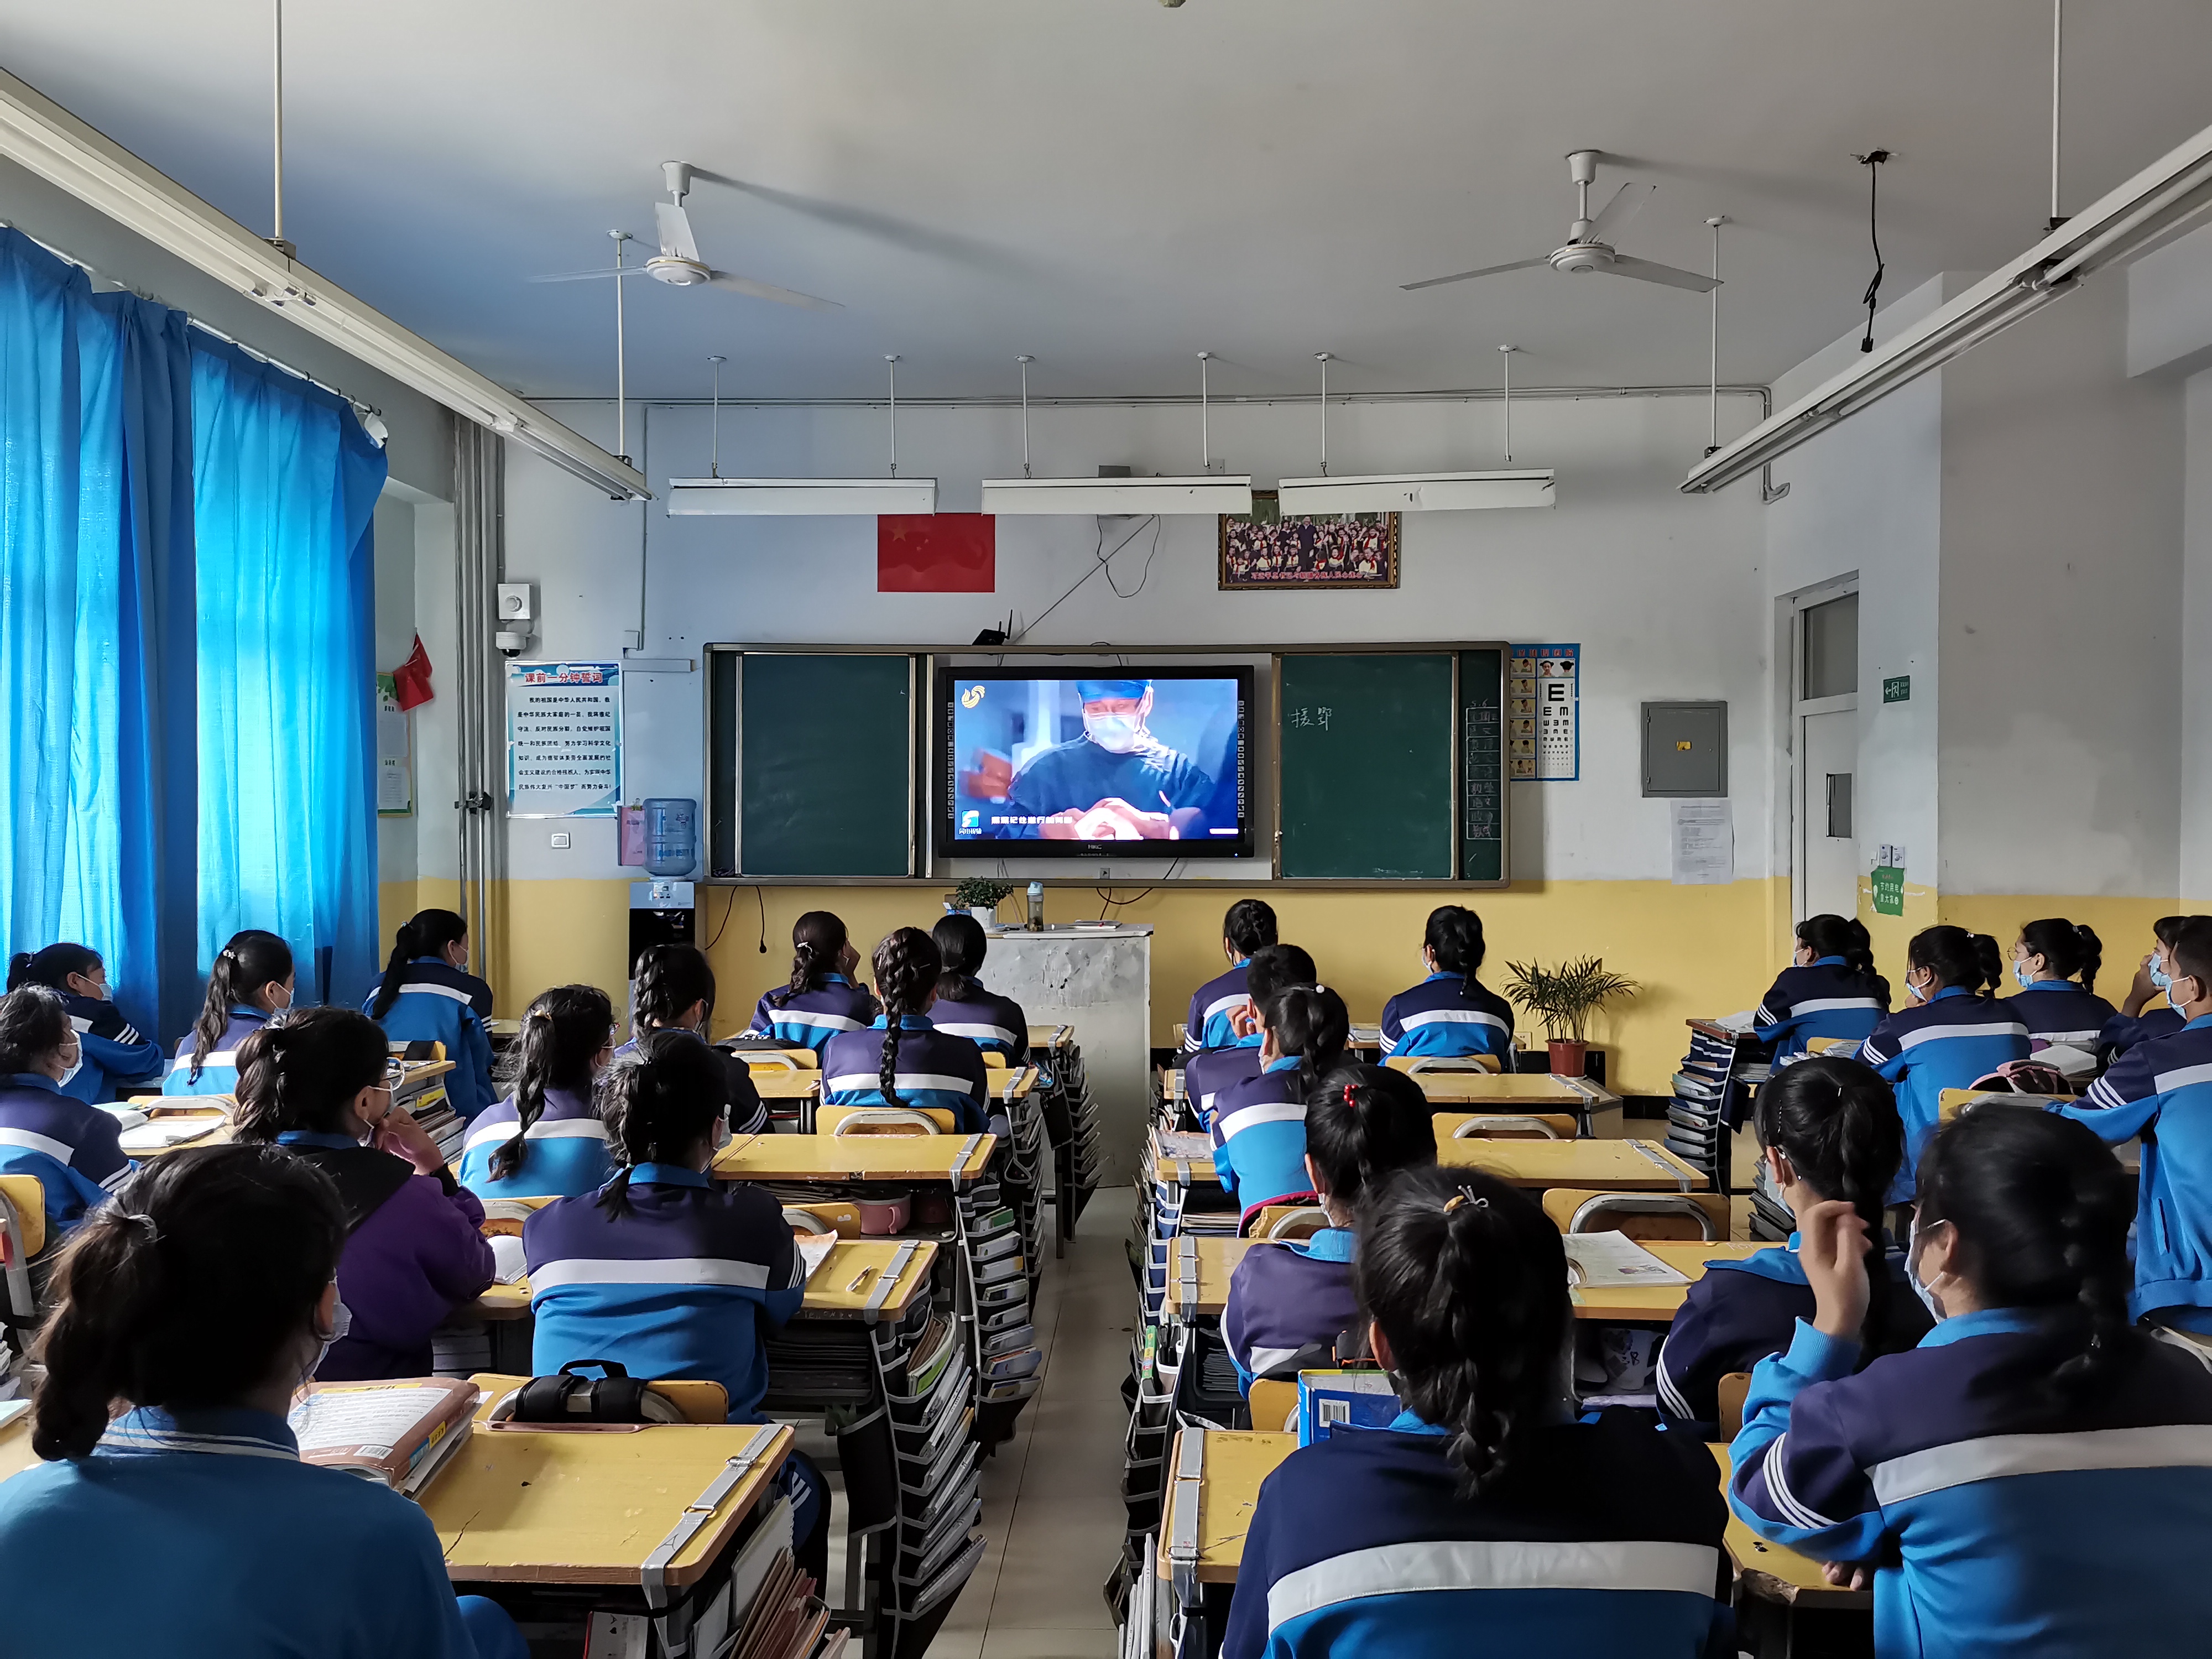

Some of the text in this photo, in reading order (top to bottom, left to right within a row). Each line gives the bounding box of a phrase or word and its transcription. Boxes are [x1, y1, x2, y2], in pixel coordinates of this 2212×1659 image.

[525, 672, 603, 683] 课前一分钟誓词
